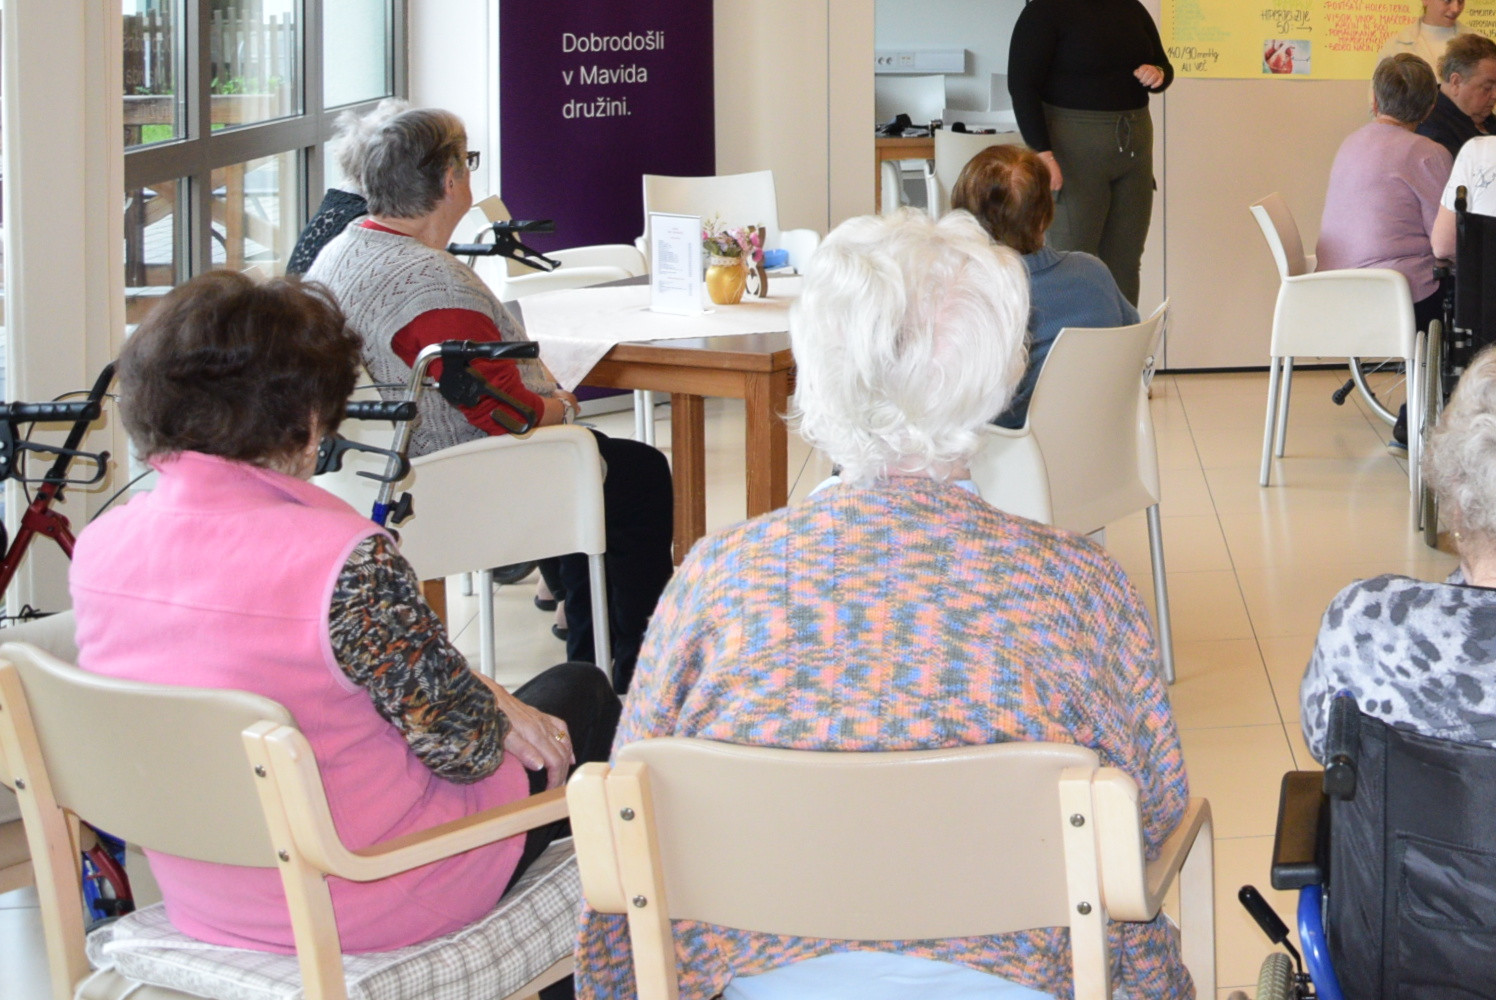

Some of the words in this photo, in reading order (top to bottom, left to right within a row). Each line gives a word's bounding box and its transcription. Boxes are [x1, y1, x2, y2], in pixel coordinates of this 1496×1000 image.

[562, 30, 664, 53] Dobrodošli
[562, 71, 573, 86] v
[580, 64, 648, 86] Mavida
[562, 97, 632, 119] družini.
